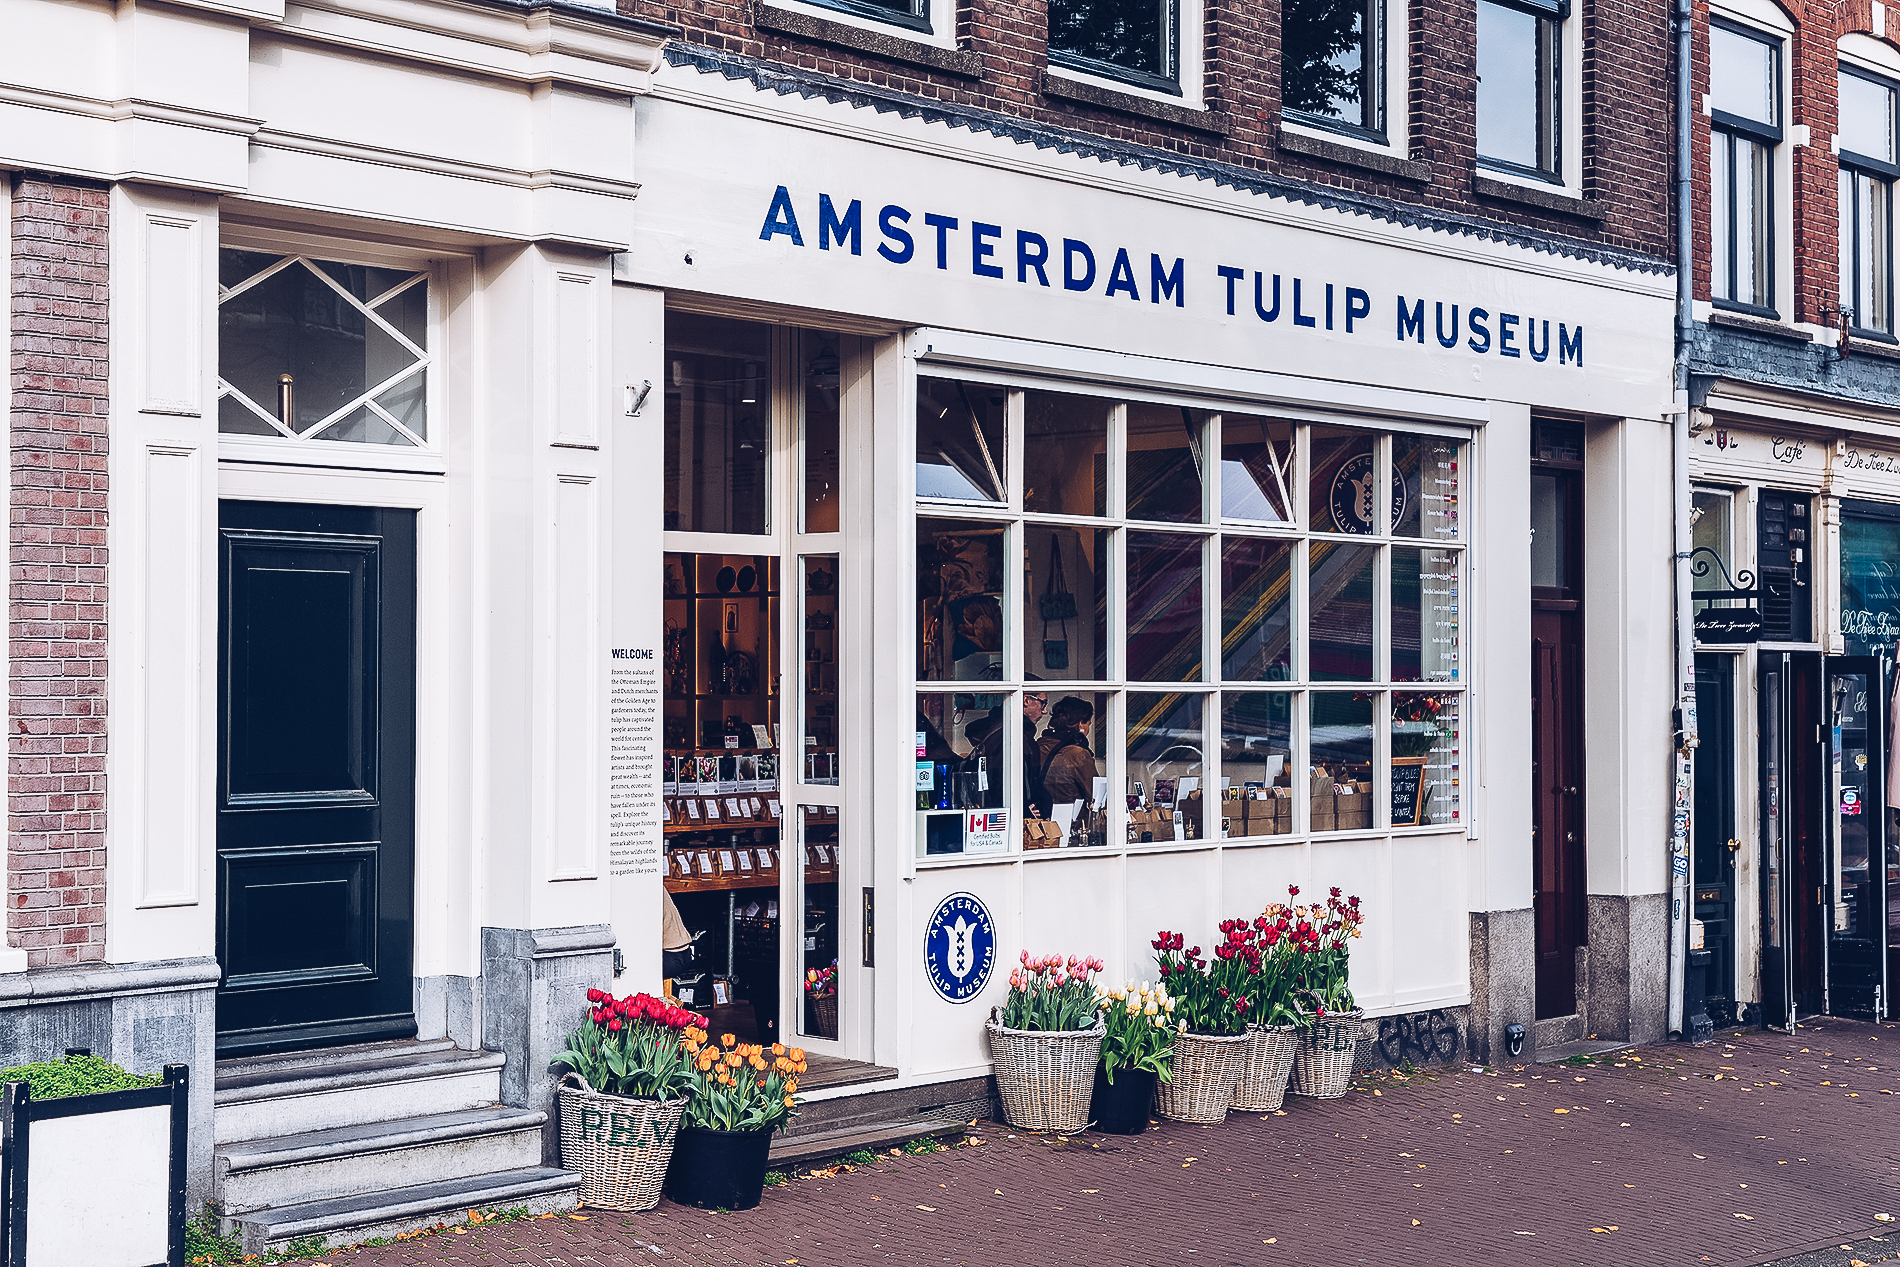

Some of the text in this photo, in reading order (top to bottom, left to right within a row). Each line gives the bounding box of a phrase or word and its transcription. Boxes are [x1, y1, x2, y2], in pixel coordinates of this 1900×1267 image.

[758, 184, 1583, 368] AMSTERDAM TULIP MUSEUM
[1771, 435, 1807, 464] Café
[1844, 448, 1863, 469] De
[1337, 457, 1400, 490] AMSTEM
[611, 648, 654, 660] WELCOME
[930, 898, 991, 939] AMSTERDAM
[928, 952, 951, 992] TULIP
[957, 946, 993, 998] MUSEUM
